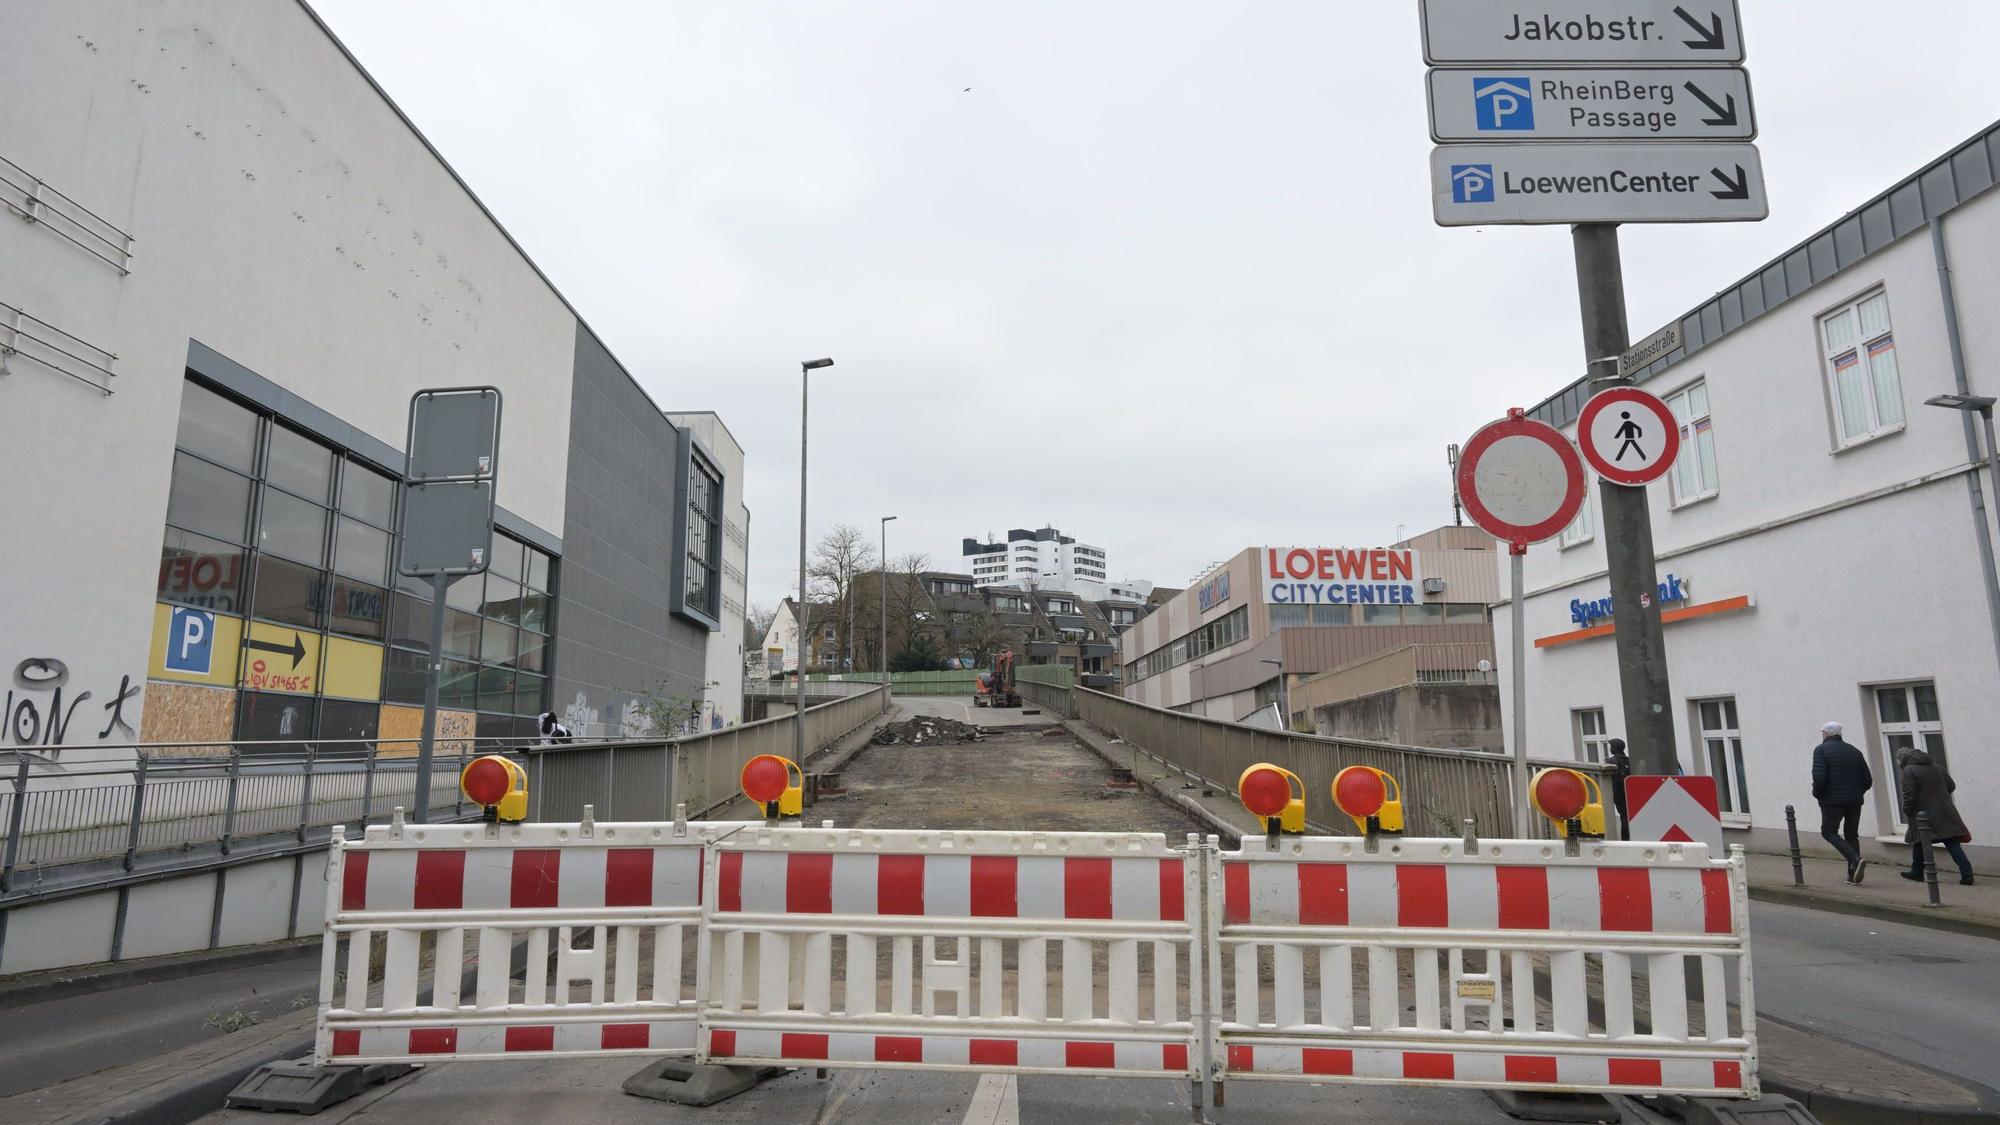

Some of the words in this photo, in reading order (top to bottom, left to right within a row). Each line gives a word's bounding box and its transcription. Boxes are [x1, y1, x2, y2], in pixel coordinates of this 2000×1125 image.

[1504, 14, 1664, 41] Jakobstr.
[1541, 79, 1675, 106] RheinBerg
[1570, 107, 1678, 133] Passage
[1503, 170, 1701, 195] LoewenCenter
[1623, 330, 1675, 370] Stationsstraße
[1268, 548, 1413, 580] LOEWEN
